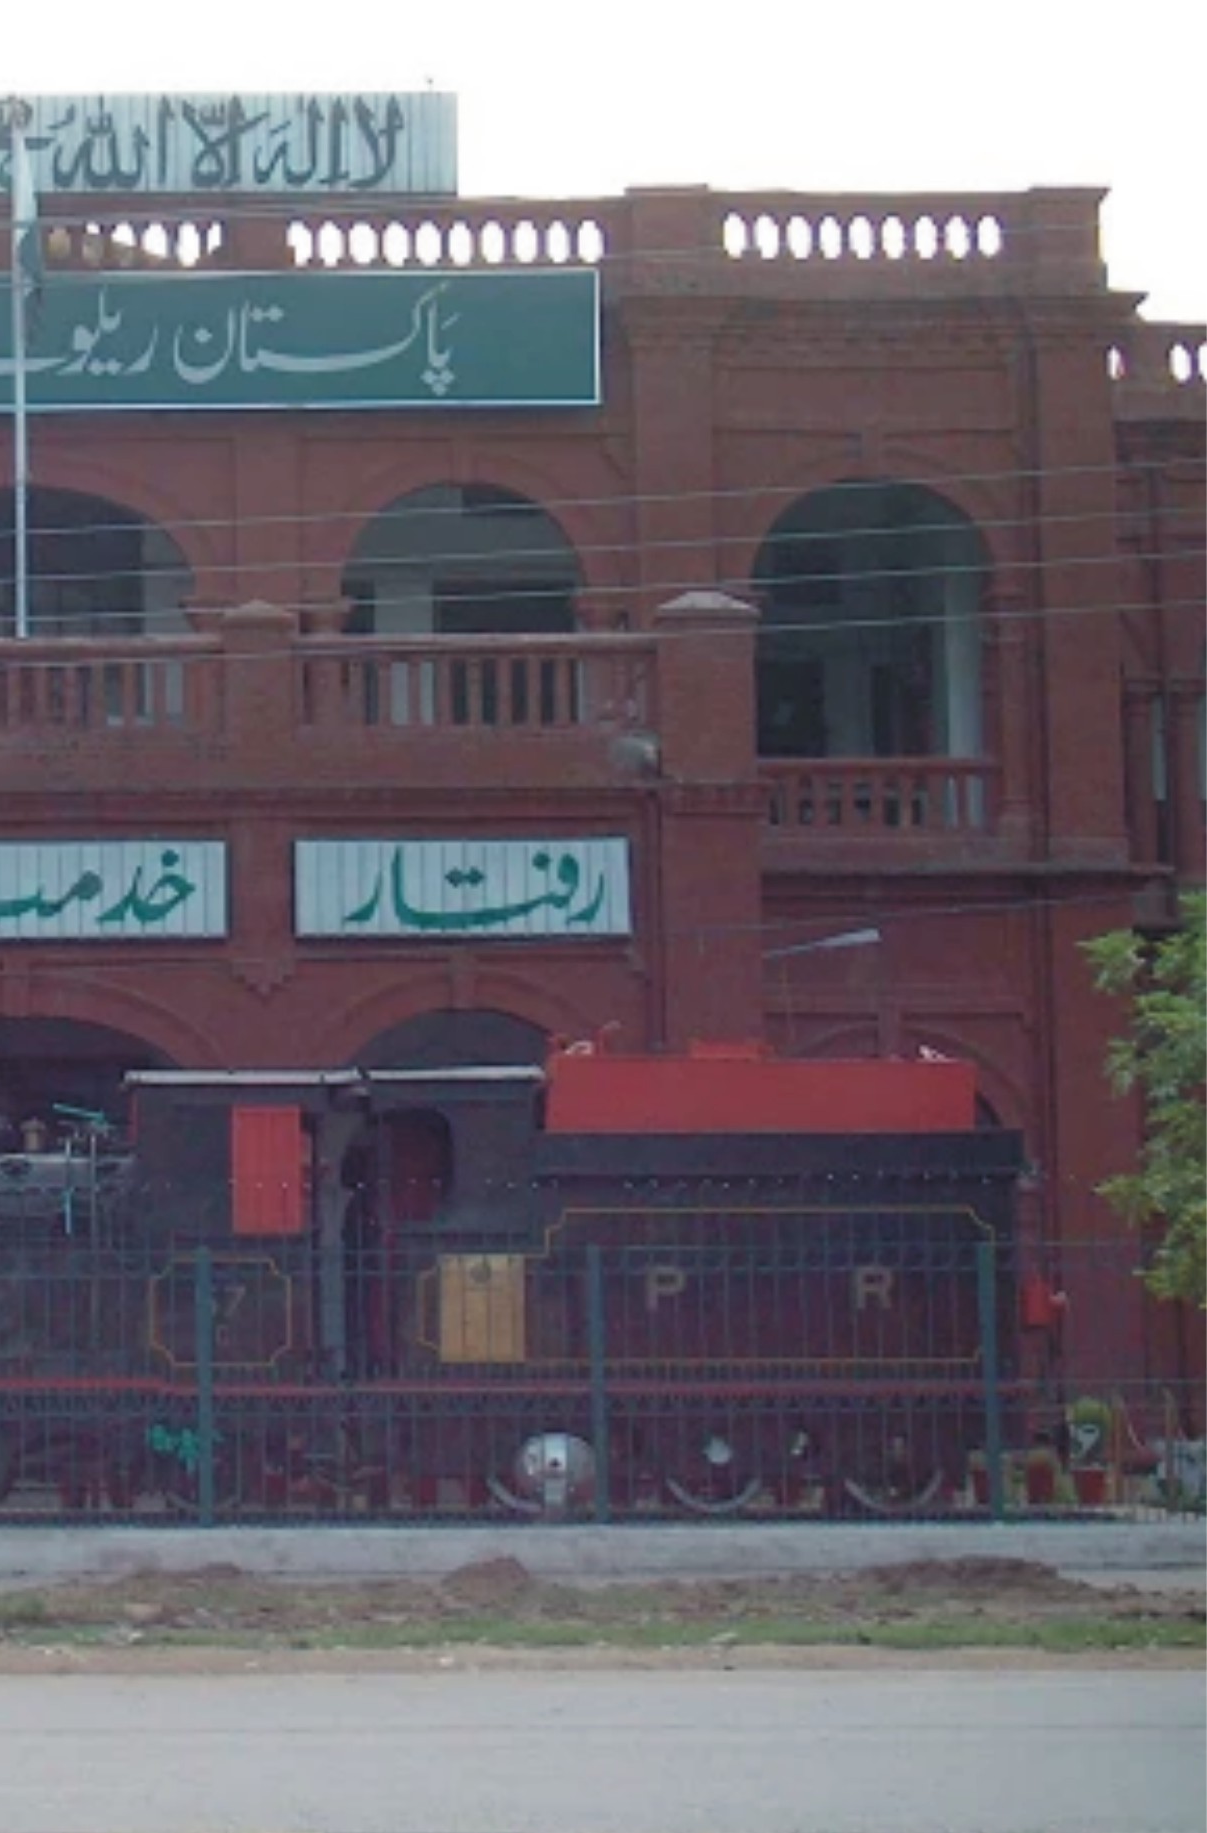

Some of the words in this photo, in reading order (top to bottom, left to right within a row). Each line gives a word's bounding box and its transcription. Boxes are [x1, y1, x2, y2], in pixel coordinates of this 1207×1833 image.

[173, 281, 461, 397] پاکستان
[342, 846, 606, 930] رفتار
[646, 1265, 686, 1310] P
[855, 1265, 893, 1309] R
